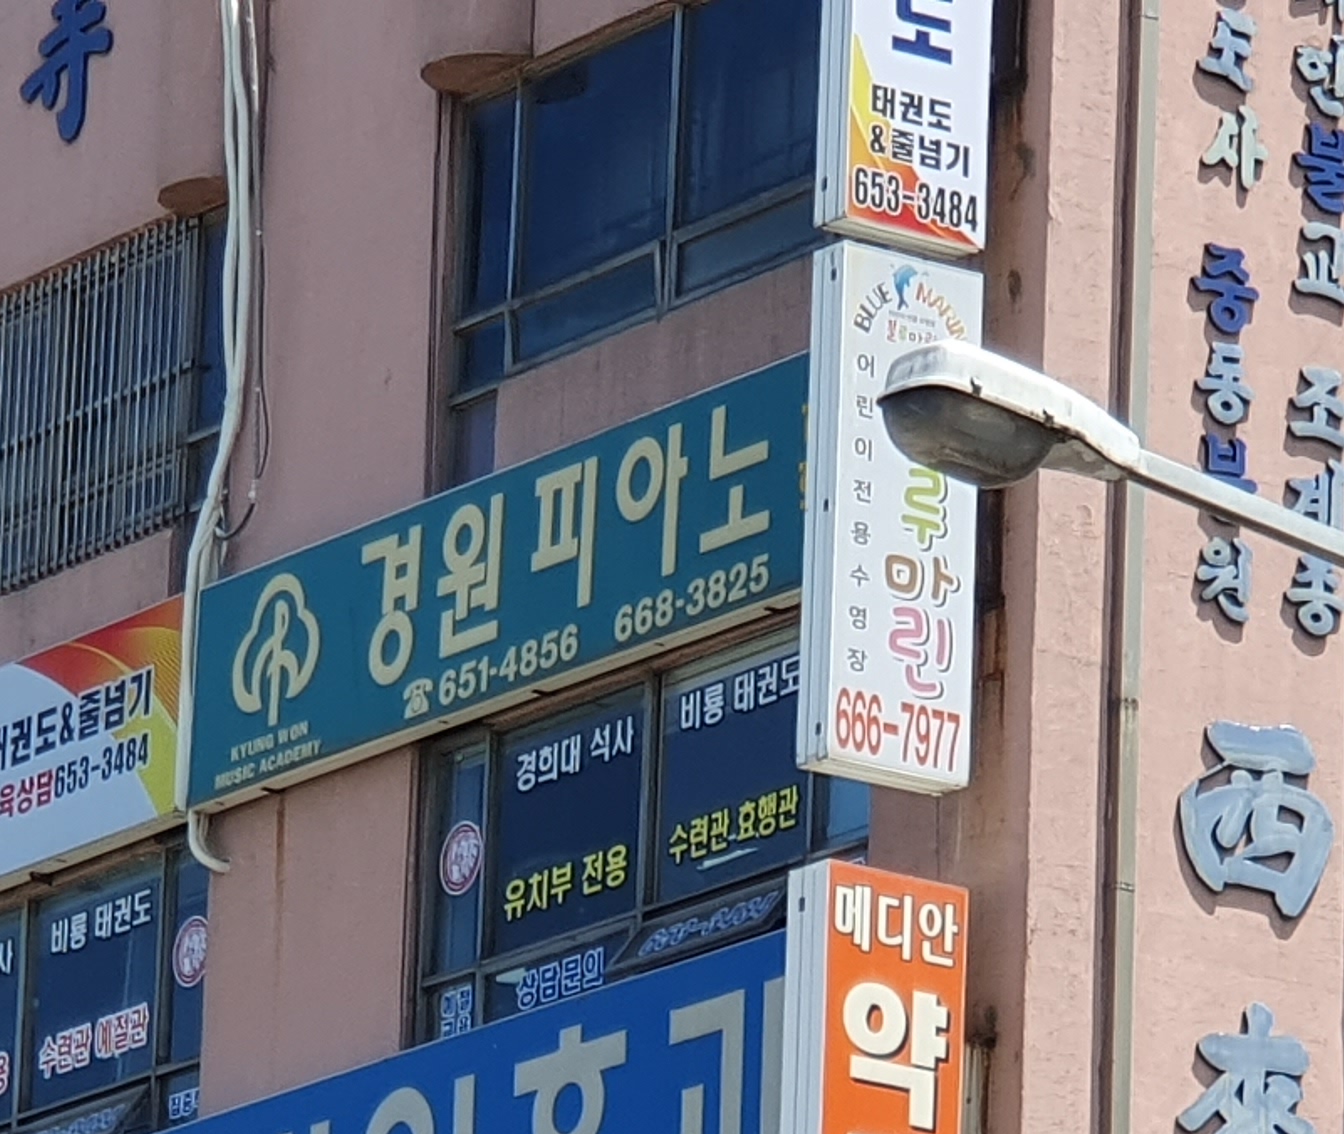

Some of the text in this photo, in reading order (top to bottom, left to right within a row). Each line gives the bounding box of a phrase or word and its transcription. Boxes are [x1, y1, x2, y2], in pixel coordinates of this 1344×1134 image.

[872, 83, 952, 133] 태권도
[854, 167, 978, 233] 653-3484
[853, 281, 894, 333] BLUE
[613, 553, 771, 644] 668-3825
[438, 623, 581, 705] 651-4856
[277, 720, 308, 744] WON
[679, 687, 725, 732] 비룡
[835, 687, 961, 772] 666-7977
[54, 731, 150, 801] 653-3484
[515, 714, 636, 793] 경희대 석사
[668, 806, 732, 866] 수련관
[503, 863, 574, 923] 유치부
[580, 844, 629, 895] 전용
[50, 889, 152, 955] 비룡 태권도
[833, 883, 960, 968] 메디안
